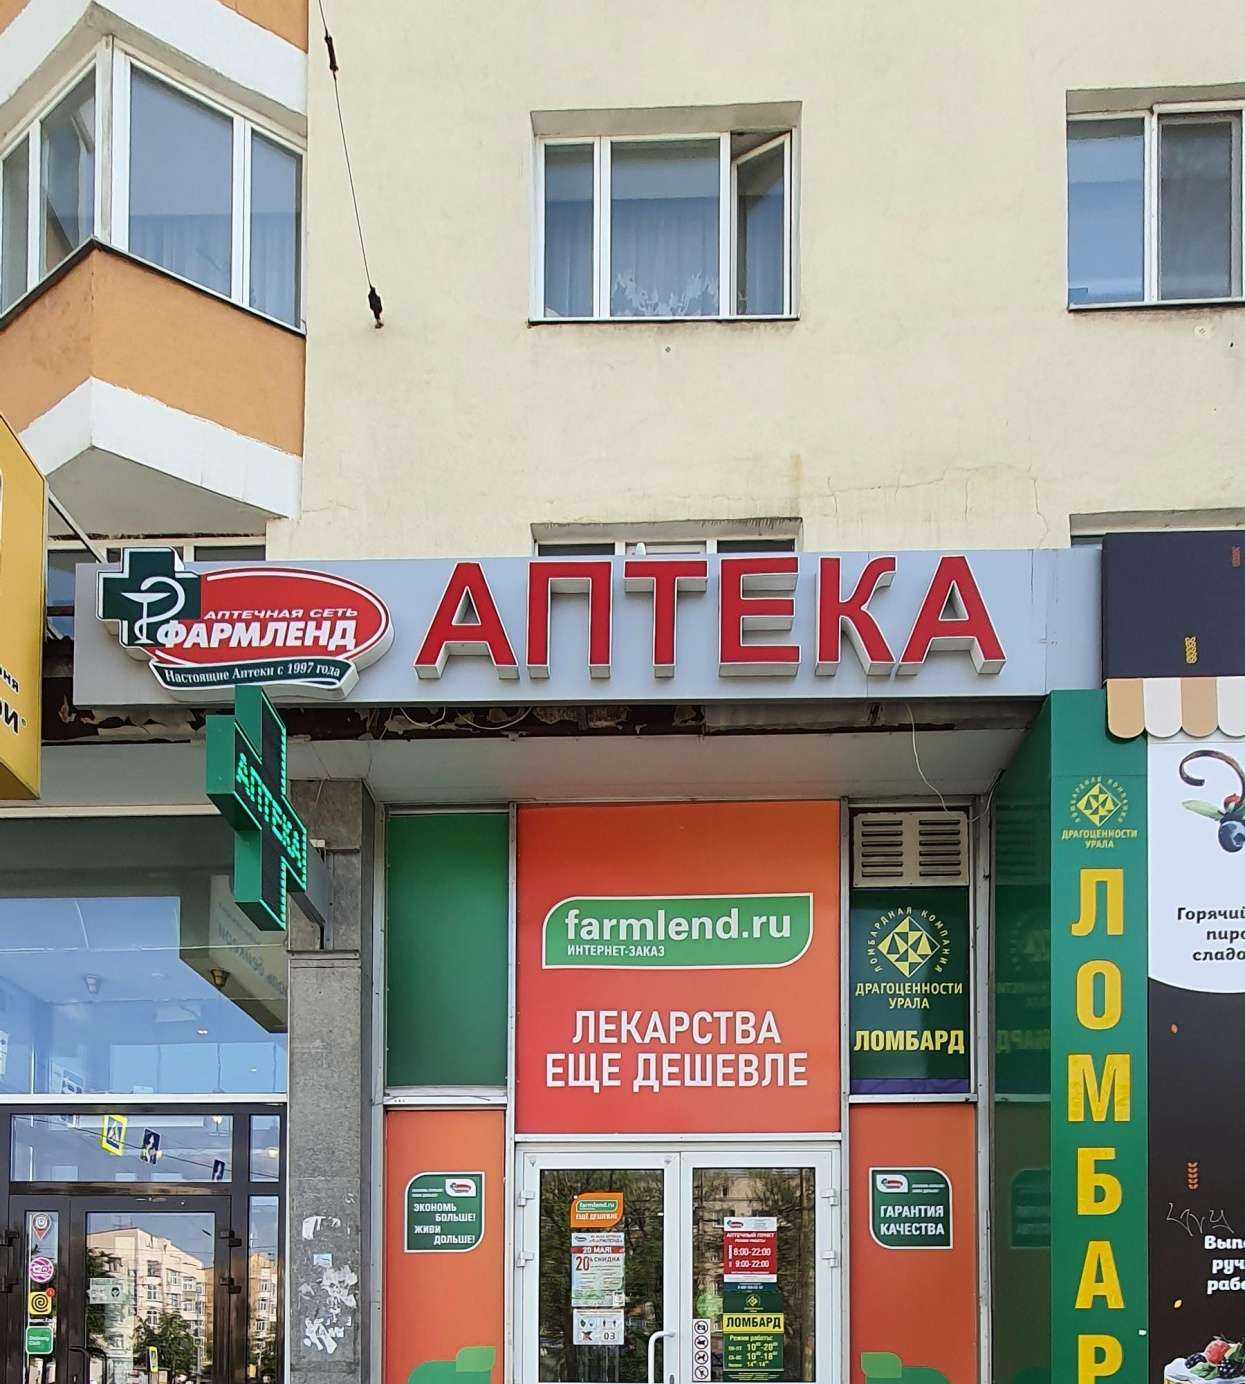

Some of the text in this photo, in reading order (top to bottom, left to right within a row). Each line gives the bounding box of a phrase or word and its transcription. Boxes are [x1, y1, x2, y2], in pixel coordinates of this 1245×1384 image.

[203, 608, 358, 620] АПТЕЧНАЯ СЕТЬ
[413, 555, 1008, 672] АПТЕКА
[156, 620, 357, 651] ФАРМЛЕНД
[165, 662, 341, 684] Настоящие Аптеки с 1997 года
[236, 752, 302, 868] АПТЕКА
[1061, 829, 1138, 840] ДРАГОЦЕННОСТИ
[1085, 840, 1114, 848] УРАЛА
[565, 908, 791, 941] farmlend.ru
[867, 906, 950, 973] ЛОМБАРДНАЯ КОМПАНИЯ
[567, 944, 665, 957] ИНТЕРНЕТ-ЗАКАЗ
[855, 982, 963, 997] ДРАГОЦЕННОСТИ
[889, 997, 930, 1009] УРАЛА
[572, 1010, 782, 1045] ЛЕКАРСТВА
[854, 1030, 965, 1054] ЛОМБАРД
[546, 1052, 808, 1093] ЕЩЕ ДЕШЕВЛЕ
[413, 1203, 457, 1212] ЭКОНОМЬ
[880, 1205, 944, 1217] ГАРАНТИЯ
[435, 1213, 476, 1222] БОЛЬШЕ!
[414, 1225, 441, 1234] ЖИВИ
[880, 1223, 945, 1235] КАЧЕСТВА
[433, 1235, 475, 1245] ДОЛЬШЕ!
[1204, 1235, 1245, 1249] Вып
[733, 1247, 771, 1256] 8:00-22:00
[726, 1317, 781, 1329] ЛОМБАРД
[603, 1332, 616, 1340] 03
